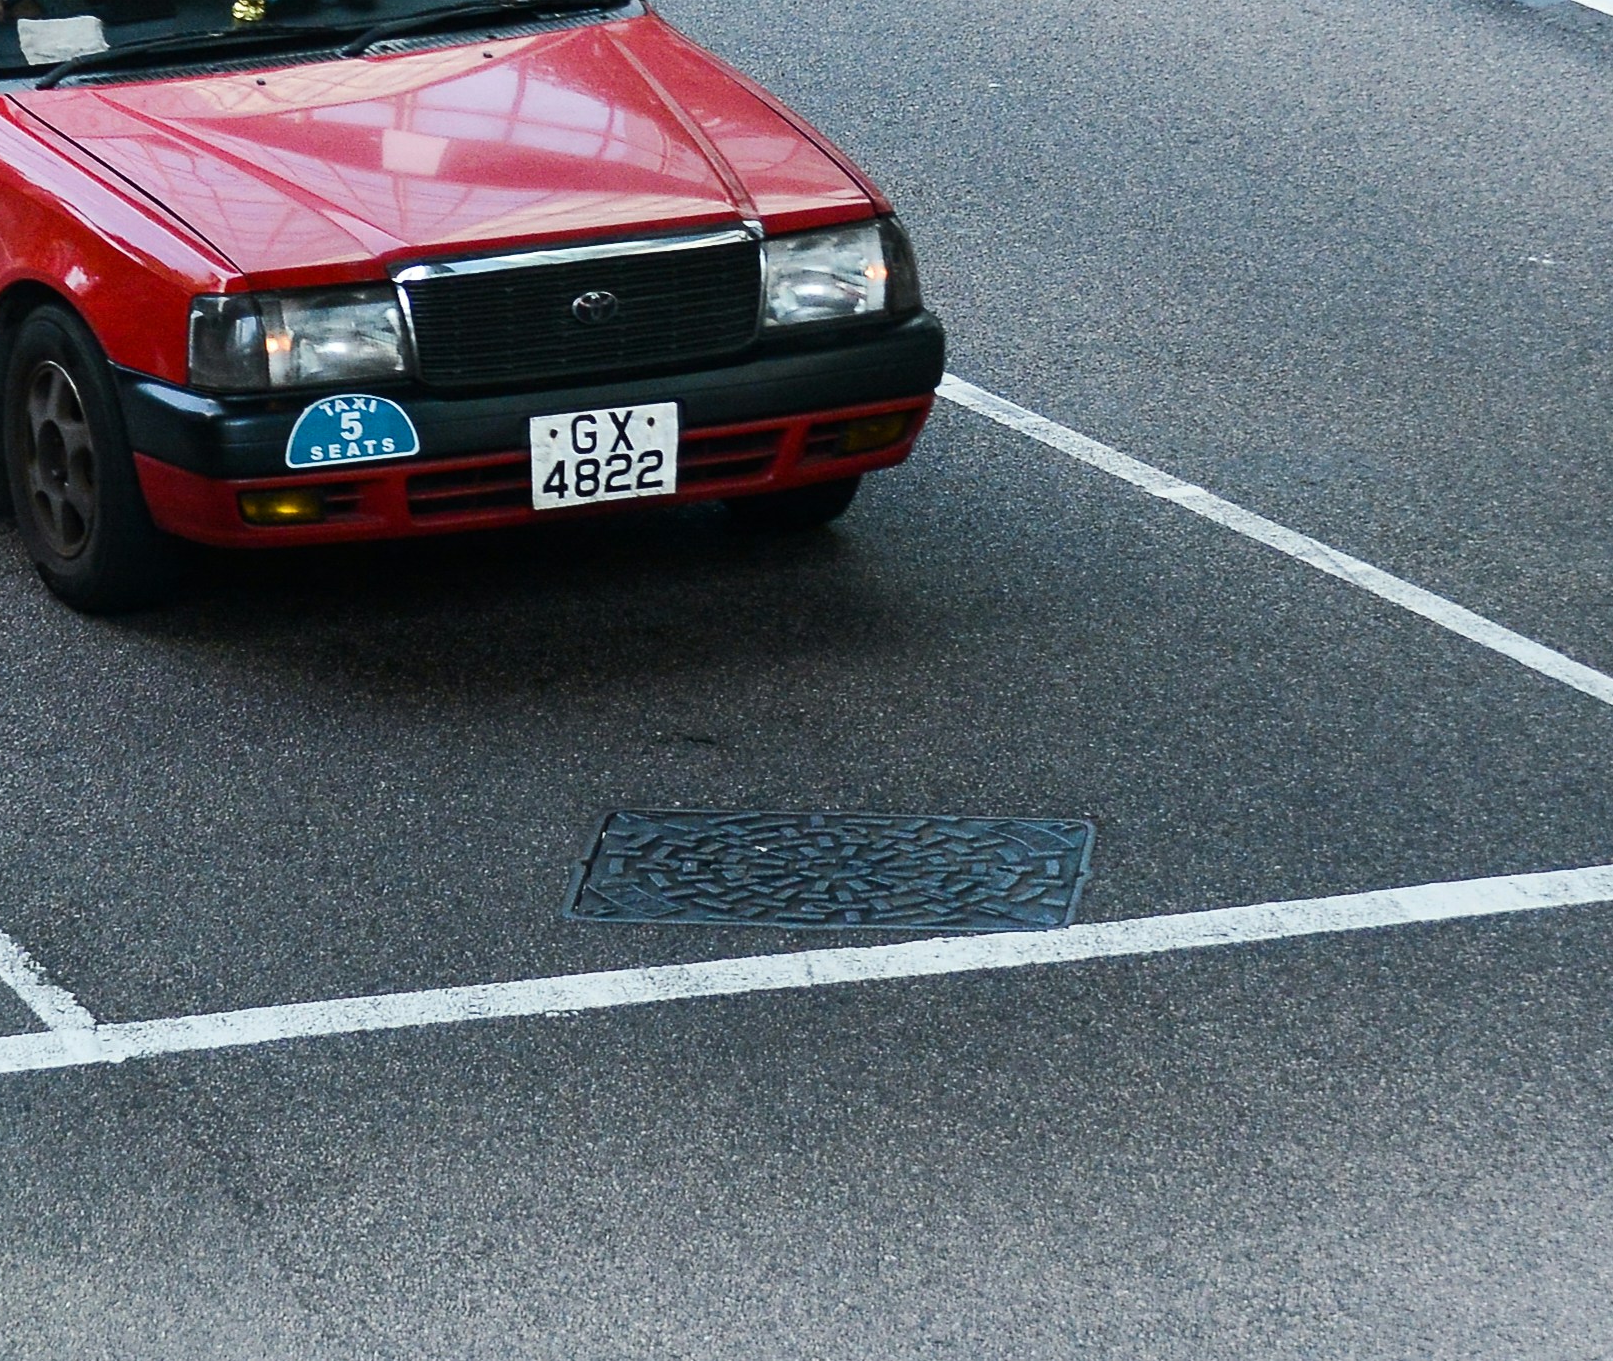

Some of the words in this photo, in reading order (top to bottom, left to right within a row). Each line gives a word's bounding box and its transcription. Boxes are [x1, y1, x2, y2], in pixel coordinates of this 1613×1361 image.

[318, 397, 378, 417] TAXI
[340, 411, 363, 441] 5
[571, 410, 634, 455] GX
[310, 437, 395, 461] SEATS
[543, 449, 664, 499] 4822
